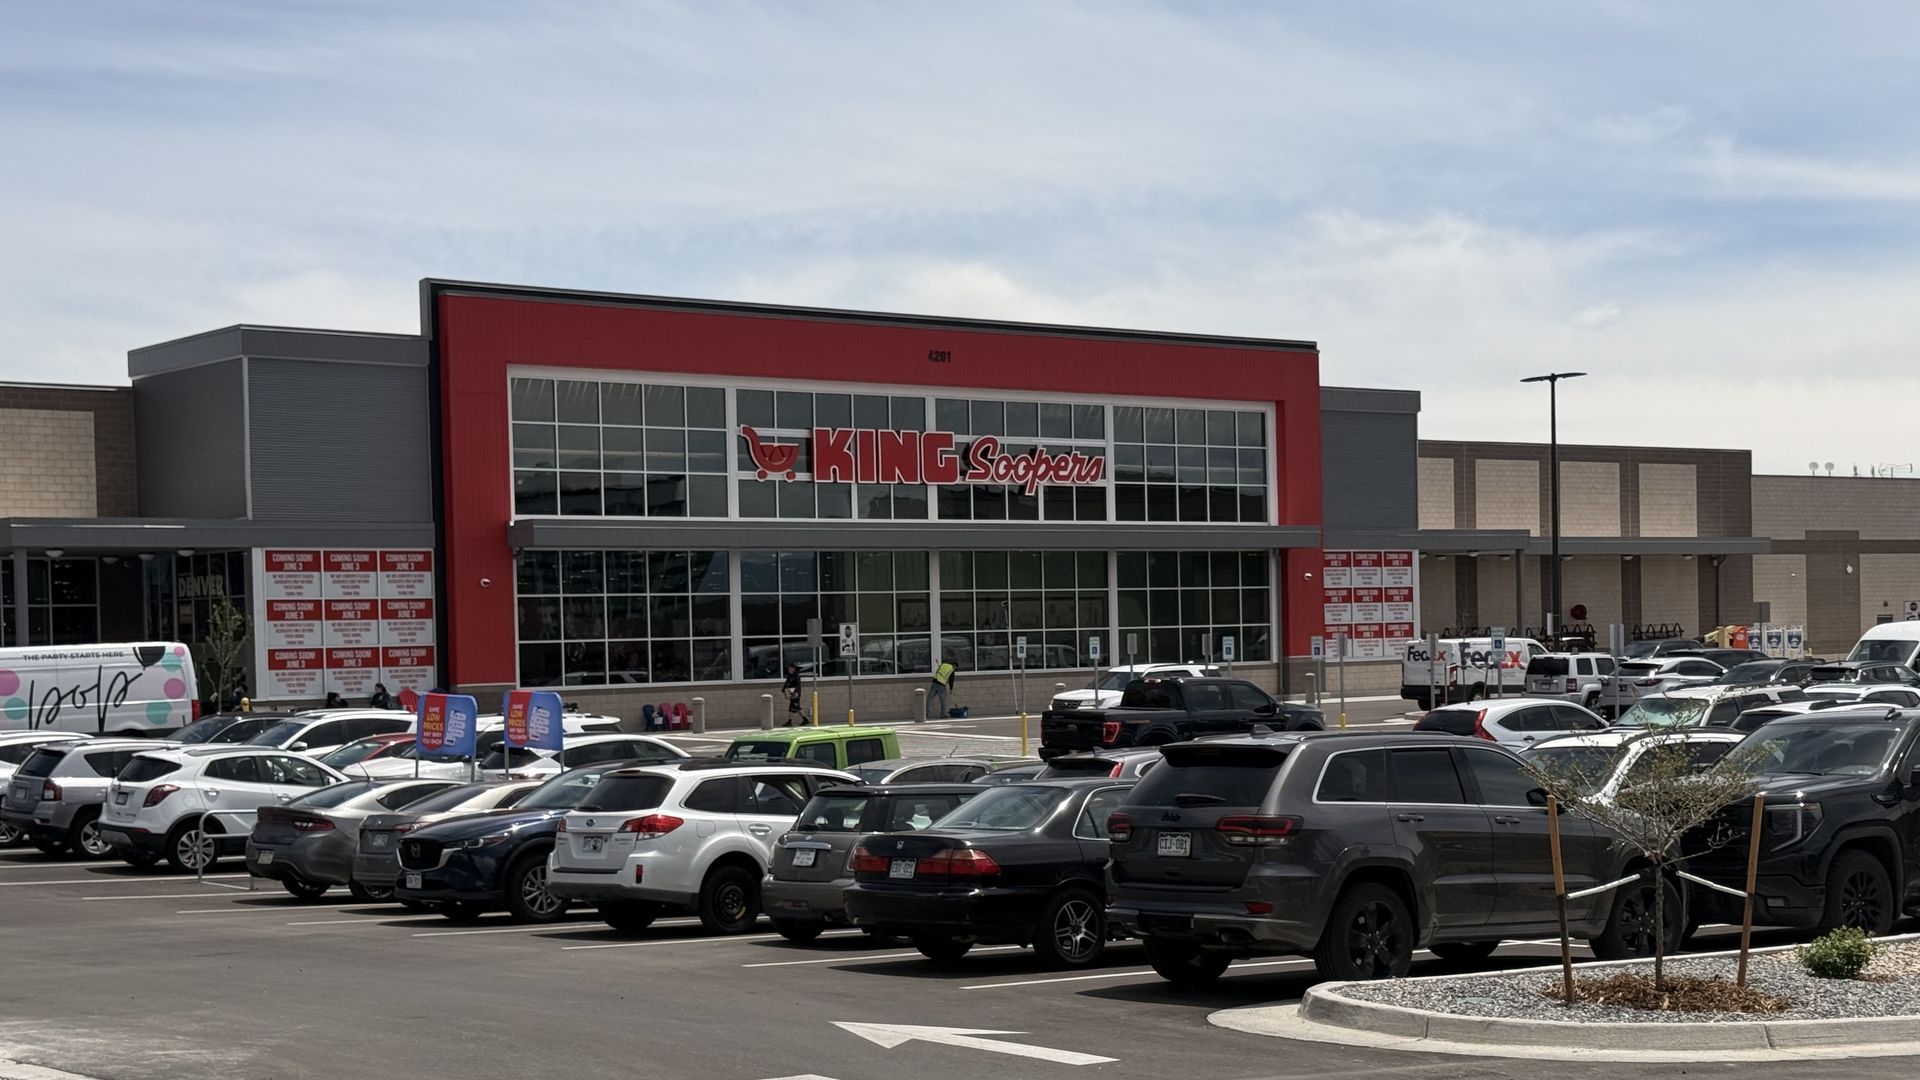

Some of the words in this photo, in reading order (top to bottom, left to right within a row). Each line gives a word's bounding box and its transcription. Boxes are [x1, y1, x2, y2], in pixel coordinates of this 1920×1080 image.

[928, 350, 952, 363] 4201
[813, 427, 960, 484] KING
[966, 435, 1104, 496] Soopers
[178, 575, 224, 597] DENVER
[398, 610, 410, 618] JUNE
[1407, 645, 1447, 661] Fedx
[286, 660, 300, 668] JUNE
[343, 659, 356, 667] JUNE
[398, 657, 411, 665] JUNE
[427, 713, 441, 721] LOW
[511, 710, 523, 718] LOW
[423, 721, 444, 731] PRICES
[509, 719, 526, 728] PRICES
